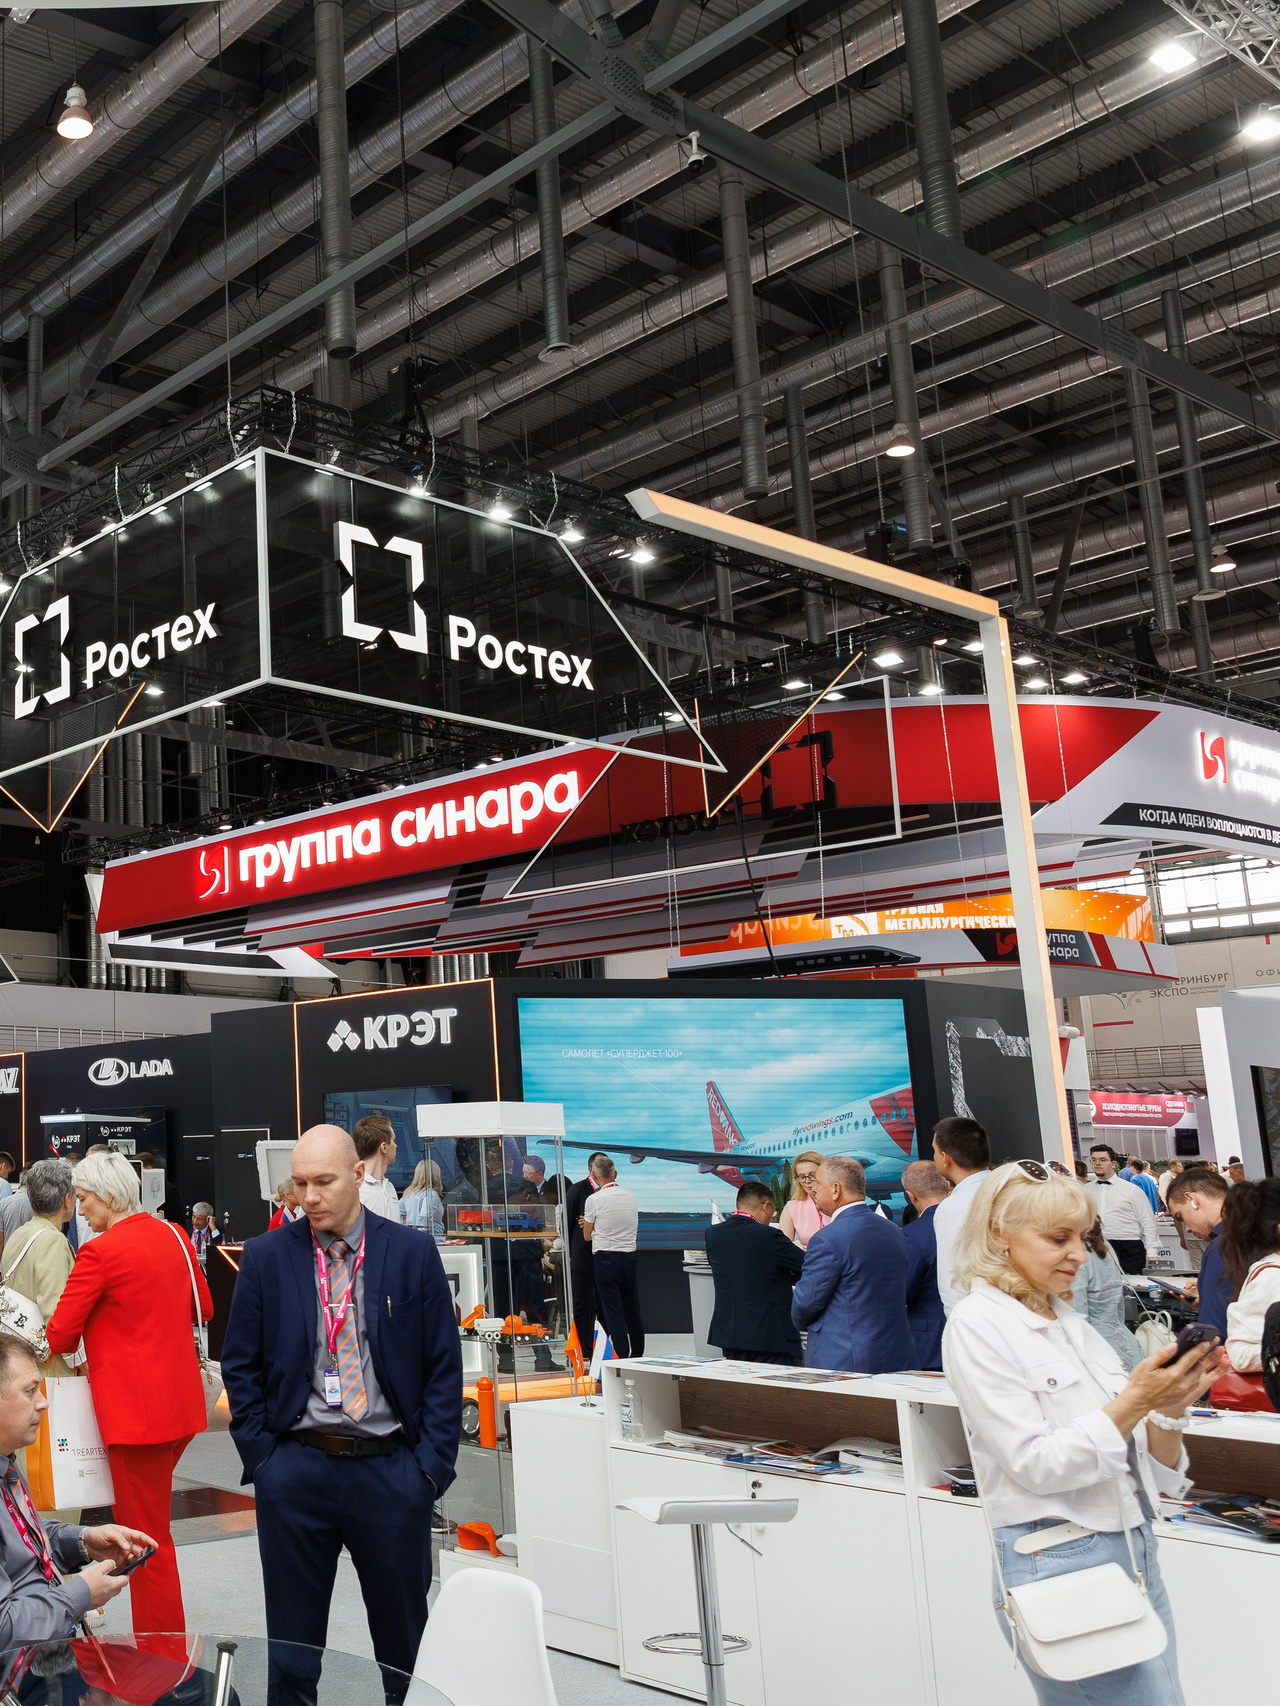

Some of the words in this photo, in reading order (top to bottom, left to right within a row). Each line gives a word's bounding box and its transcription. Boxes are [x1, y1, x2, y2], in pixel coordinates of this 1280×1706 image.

[84, 602, 217, 690] Ростех
[449, 615, 595, 692] Ростех
[239, 817, 381, 888] группа
[390, 770, 580, 842] синара
[1138, 808, 1177, 825] КОГДА
[1178, 812, 1206, 828] ИДЕИ
[1206, 816, 1266, 840] ВОПЛОЩАЮТСЯ
[1149, 986, 1189, 999] ЭКСПО
[363, 1008, 458, 1050] КРЭТ
[561, 1048, 605, 1059] САМОЛЕТ
[129, 1058, 174, 1079] LADA
[792, 1110, 853, 1137] flyredwings.com
[66, 1134, 81, 1143] КРЭТ
